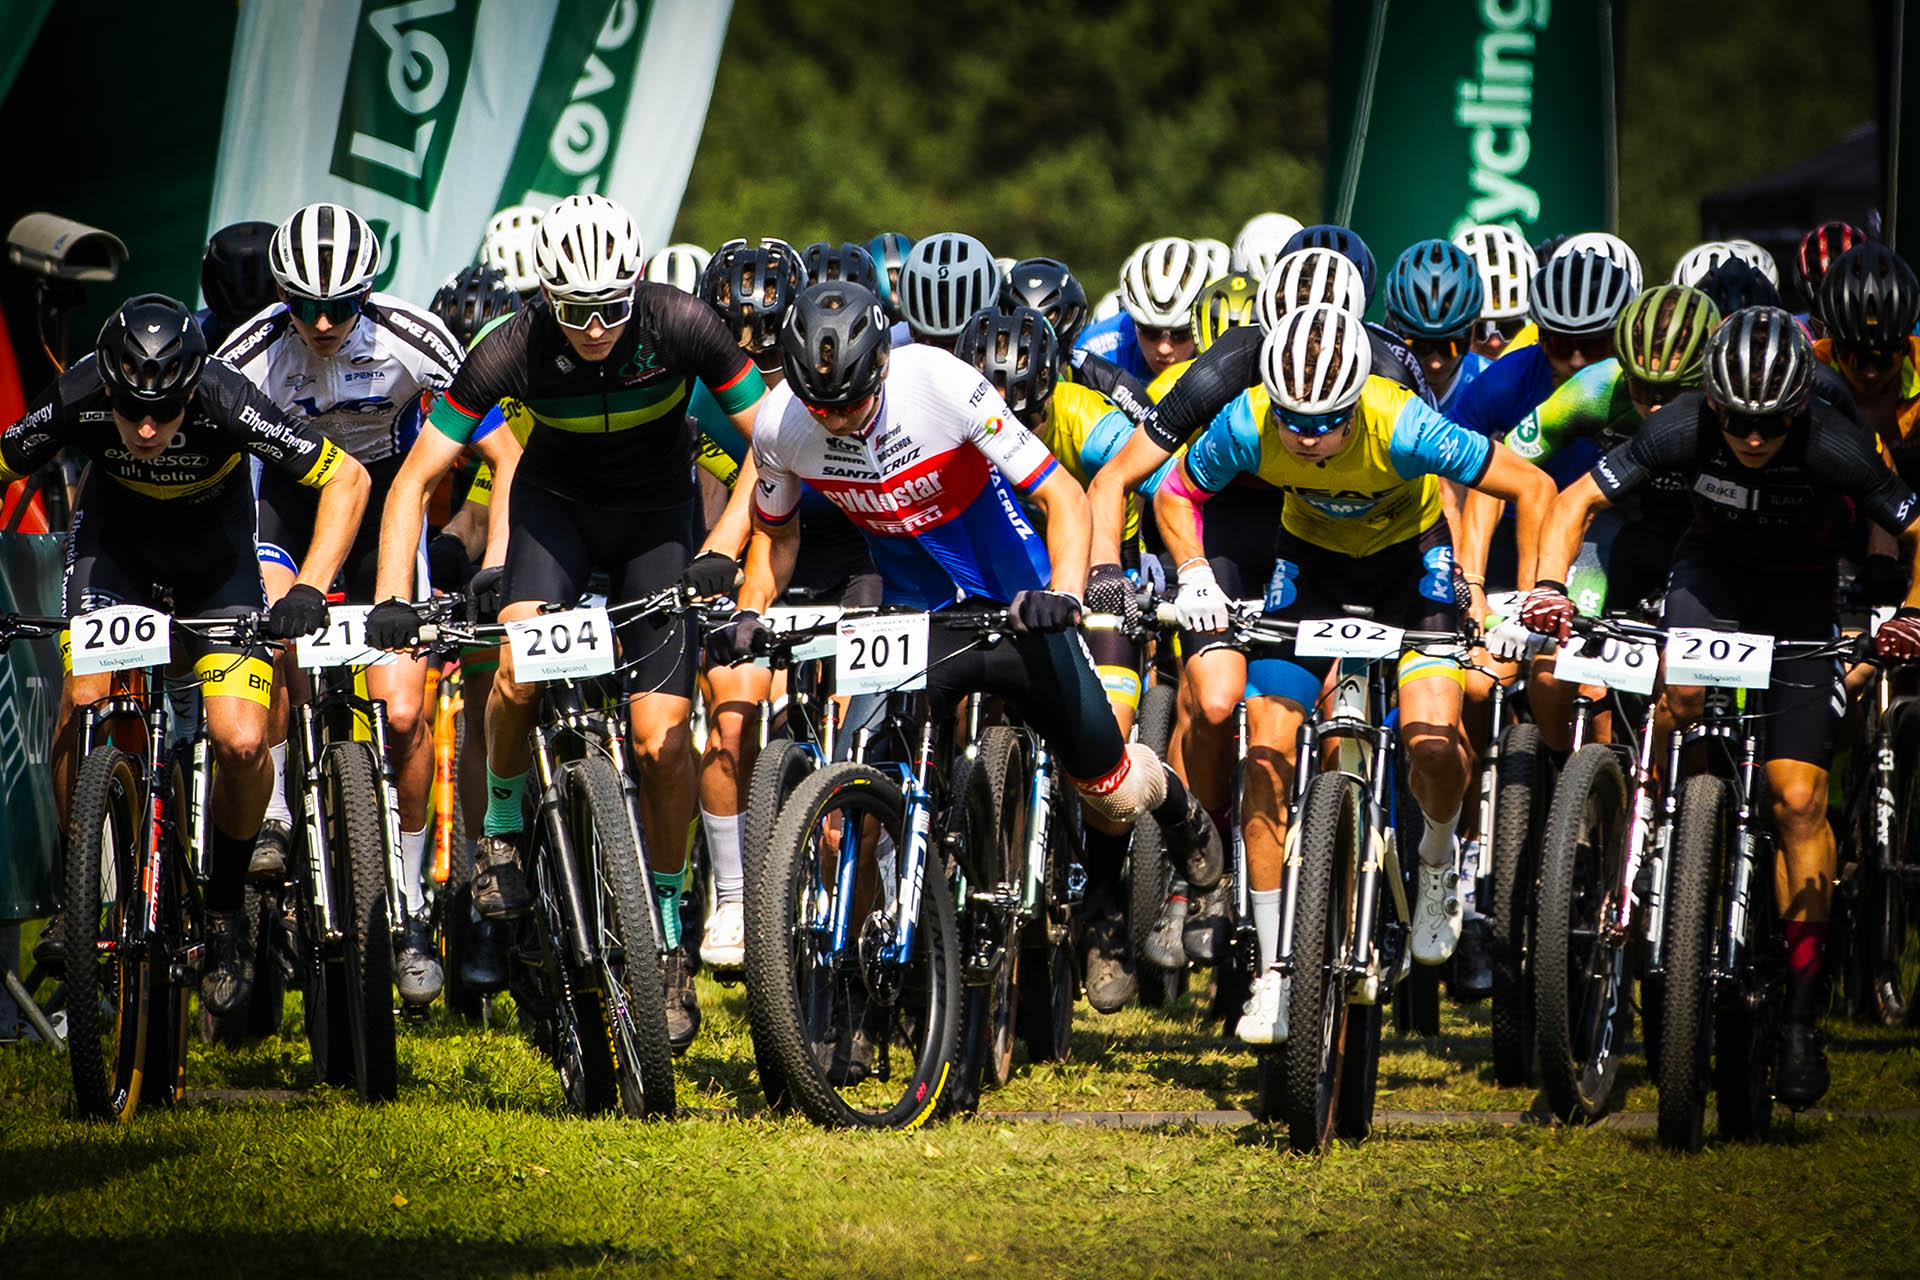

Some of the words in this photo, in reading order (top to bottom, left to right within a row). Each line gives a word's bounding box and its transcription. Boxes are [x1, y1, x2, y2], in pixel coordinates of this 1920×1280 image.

[1452, 0, 1551, 240] ycling
[389, 311, 427, 339] BIKE
[222, 321, 274, 363] FREAKS
[353, 371, 385, 380] PENTA
[84, 412, 104, 421] UCI
[281, 426, 318, 455] Energy
[822, 466, 881, 480] SANTA
[882, 446, 921, 477] CRUZ
[822, 470, 943, 513] Cyklostar
[1705, 481, 1738, 500] BIKE
[996, 488, 1035, 541] CRUZ
[1269, 557, 1286, 608] KMC
[84, 614, 156, 651] 206
[311, 619, 368, 648] 21
[524, 620, 599, 657] 204
[1313, 621, 1388, 641] 202
[850, 633, 910, 671] 201
[1574, 640, 1645, 668] 08
[1682, 637, 1758, 664] 207
